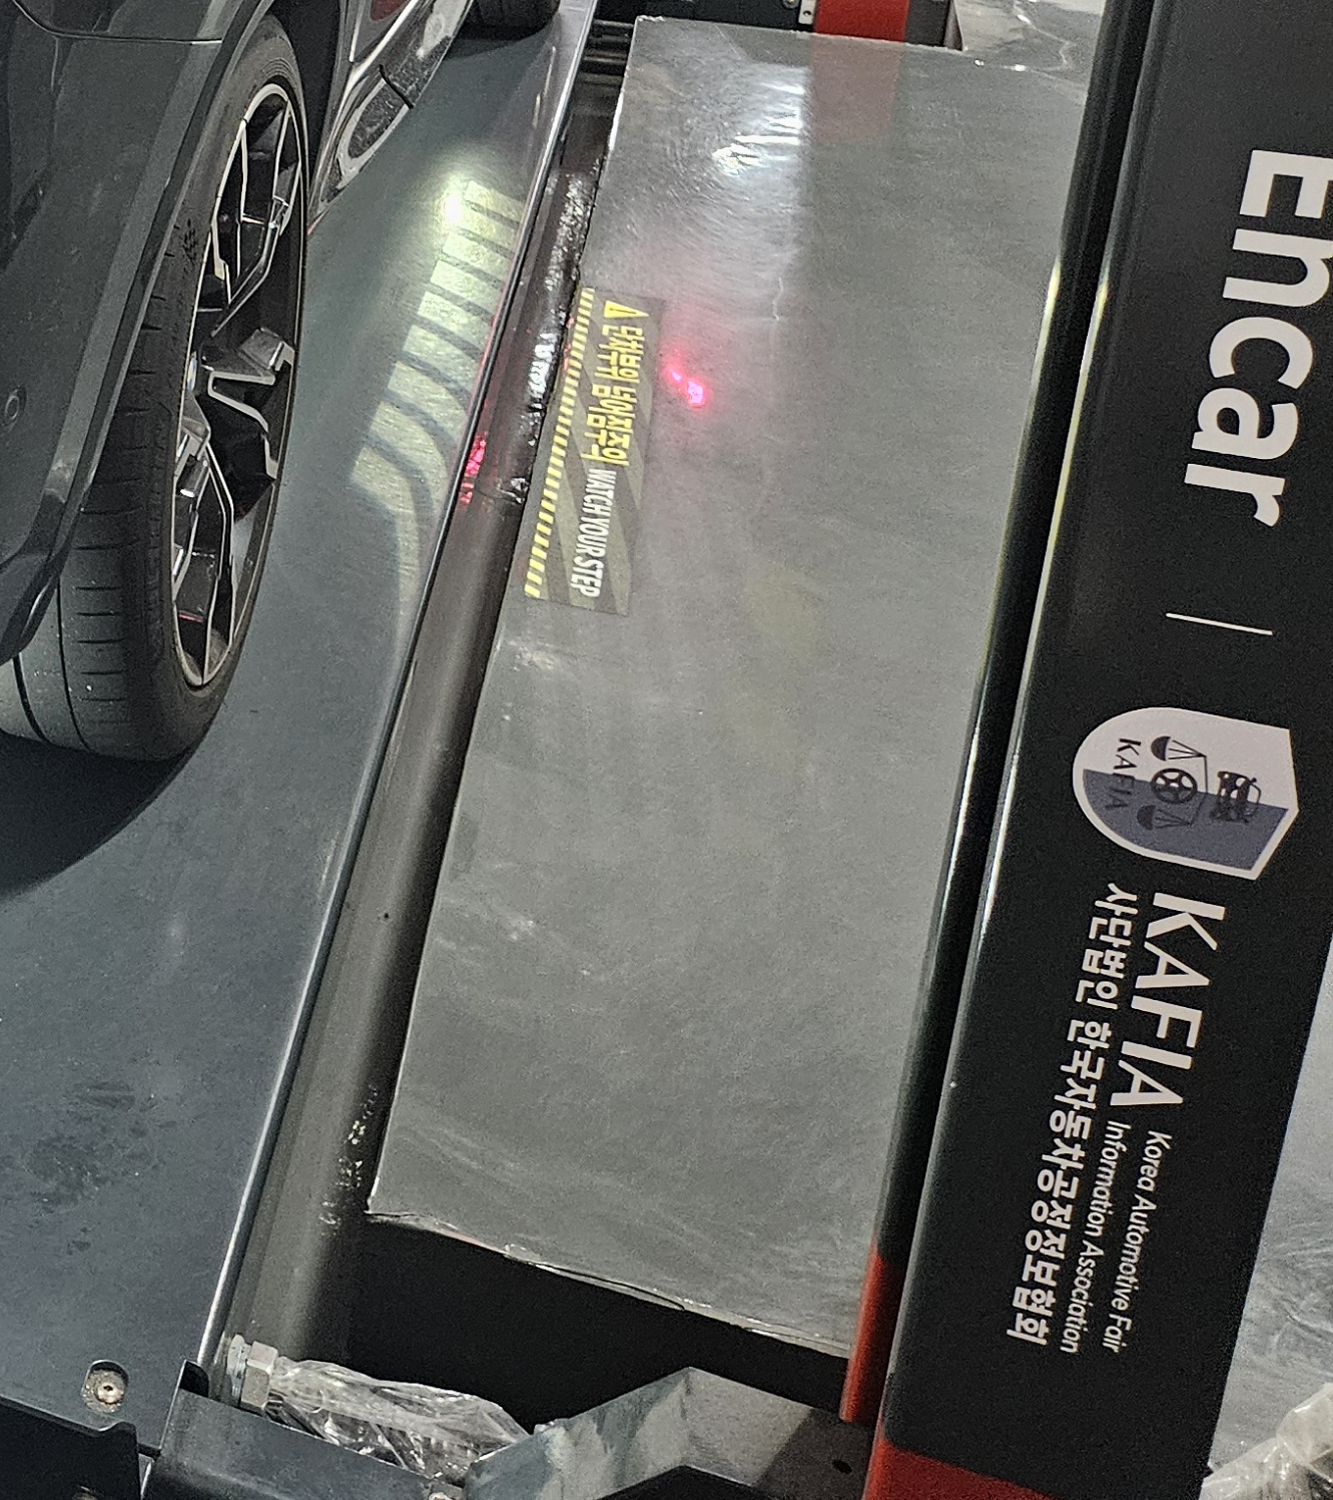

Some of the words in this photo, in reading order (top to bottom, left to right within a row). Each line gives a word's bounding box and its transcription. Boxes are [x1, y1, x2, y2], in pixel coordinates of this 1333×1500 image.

[595, 324, 645, 384] 단차부위
[1182, 149, 1333, 528] Encar
[580, 384, 637, 467] 넘어짐주의
[582, 468, 617, 516] WATCH
[570, 557, 604, 598] STEP
[576, 516, 612, 557] YOUR
[1104, 738, 1141, 810] KAFIA
[1075, 883, 1139, 1010] 사단법인
[1110, 892, 1226, 1106] KAFIA
[1006, 1019, 1112, 1346] 한국자동차공정정보협회
[1083, 1120, 1132, 1237] Information
[1136, 1130, 1173, 1192] Korea
[1111, 1194, 1157, 1311] Automotive
[1060, 1239, 1105, 1354] Association
[1102, 1313, 1133, 1353] Fair
